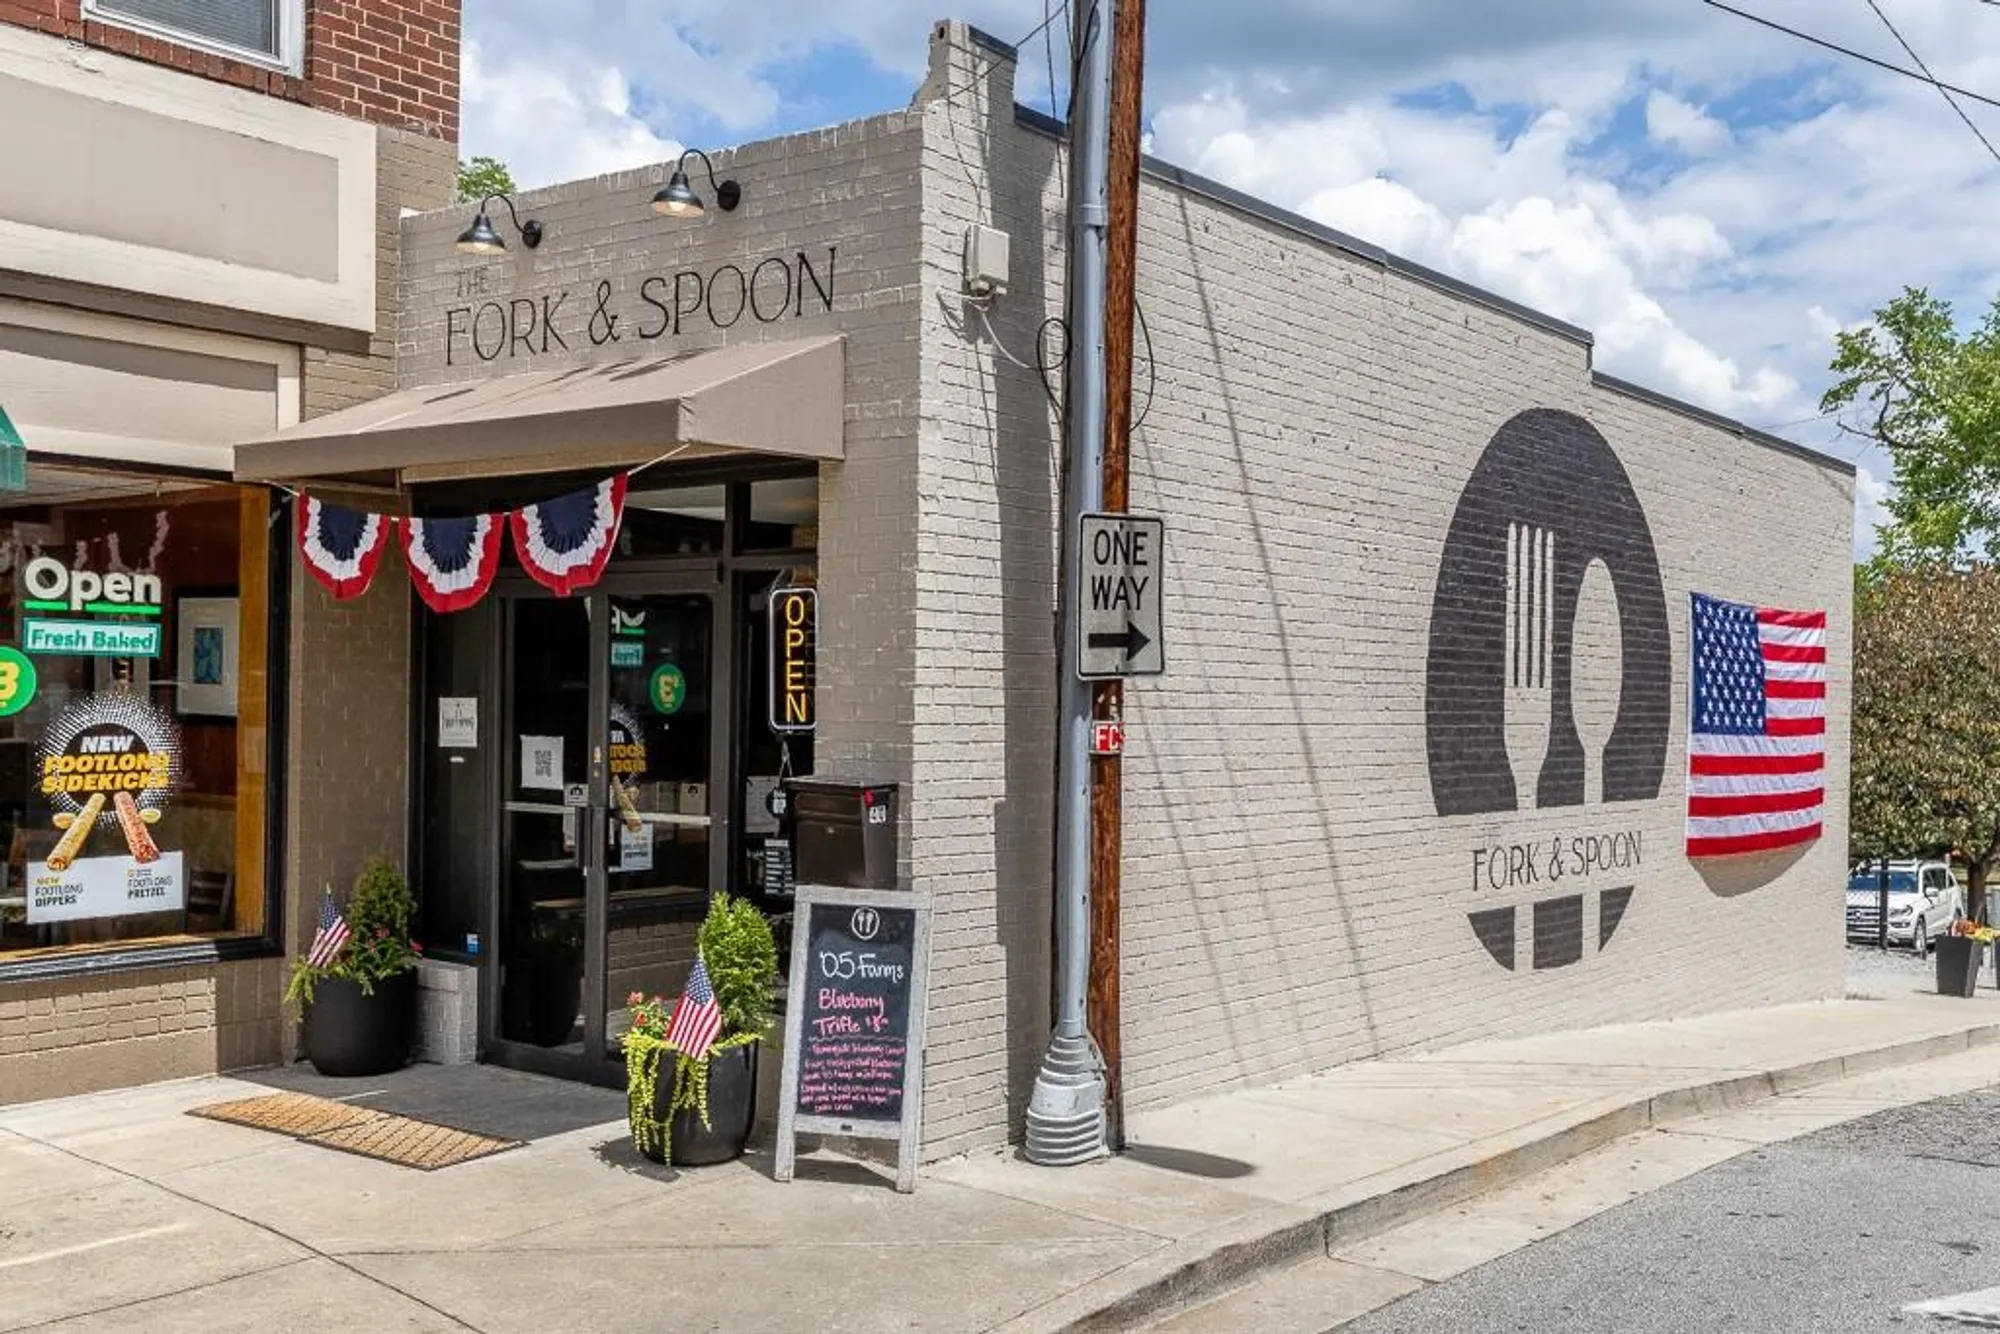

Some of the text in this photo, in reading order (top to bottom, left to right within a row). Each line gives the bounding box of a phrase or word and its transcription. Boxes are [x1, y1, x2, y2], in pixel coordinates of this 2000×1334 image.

[453, 265, 488, 298] THE
[445, 247, 837, 367] FORK & SPOON
[1093, 528, 1149, 566] ONE
[25, 556, 162, 611] Open
[1091, 575, 1149, 611] WAY
[31, 628, 154, 649] Fresh Baked
[785, 595, 807, 724] OPEN
[80, 735, 134, 753] NEW
[44, 751, 170, 774] FOOTLONG
[41, 771, 170, 793] SIDEKICKS
[1472, 842, 1540, 891] FORK
[1549, 836, 1564, 882] &
[1570, 830, 1642, 876] SPOON
[35, 895, 77, 907] DIPPERS
